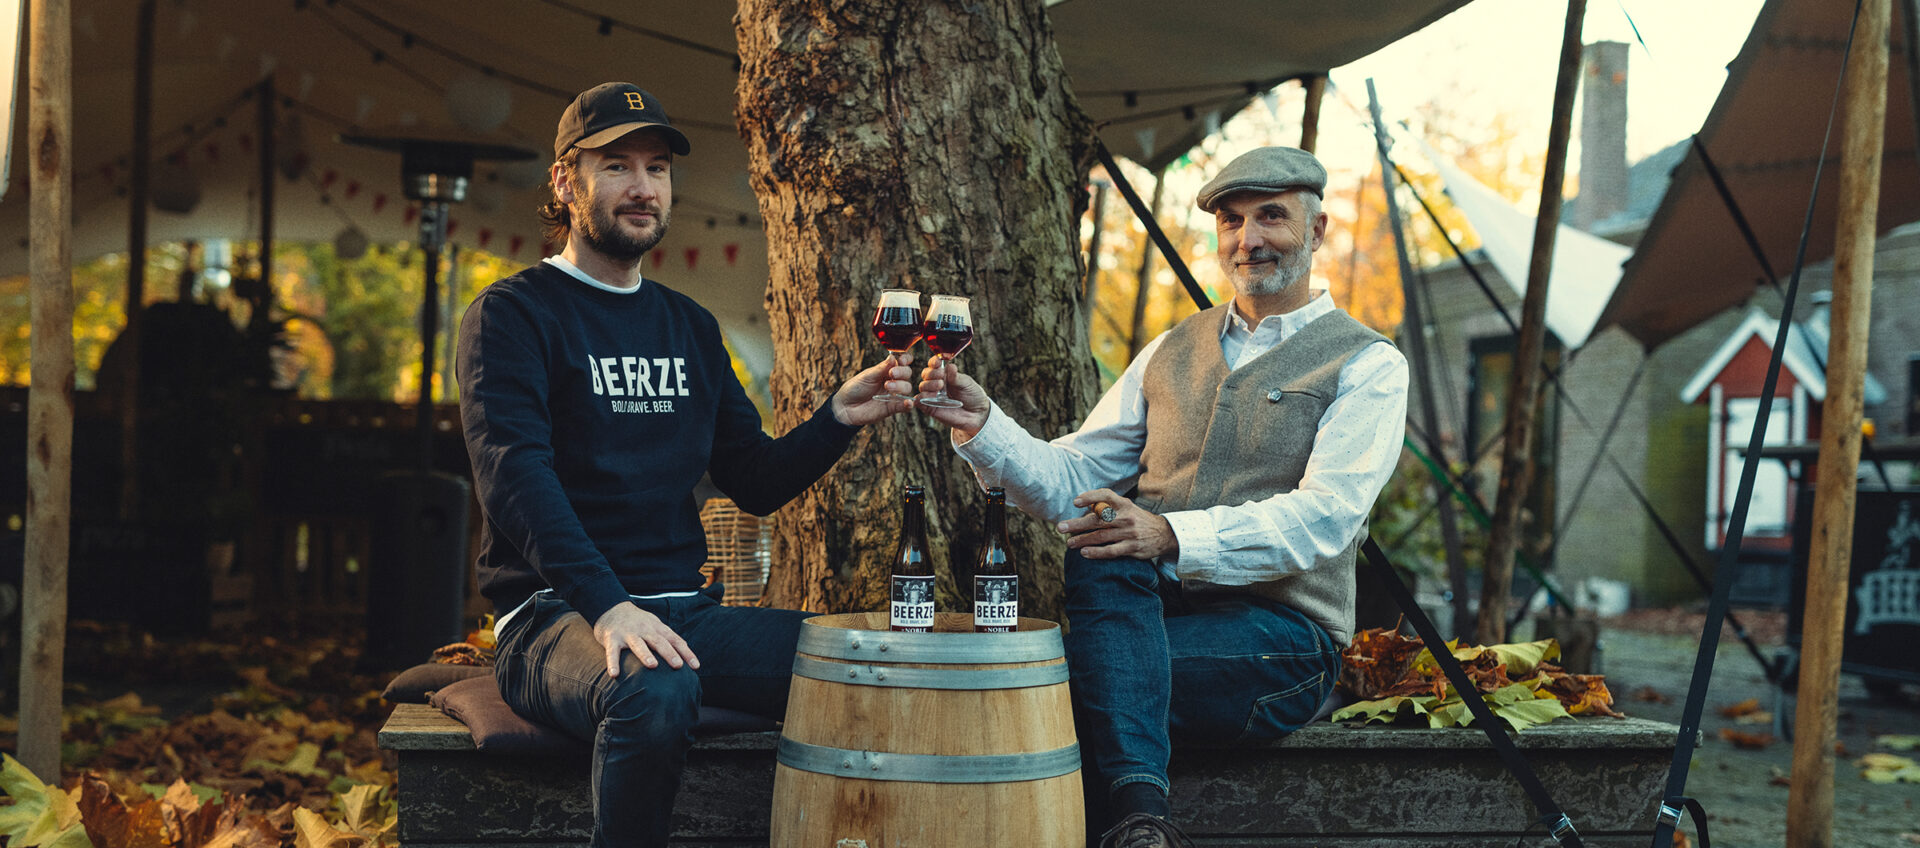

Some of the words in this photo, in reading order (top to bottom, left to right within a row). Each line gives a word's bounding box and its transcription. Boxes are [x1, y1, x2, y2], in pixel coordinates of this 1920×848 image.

[624, 92, 645, 110] B
[588, 354, 689, 397] BEERZE
[653, 400, 675, 412] BEER.
[894, 605, 933, 619] BEERZE
[976, 605, 1016, 618] BEERZE
